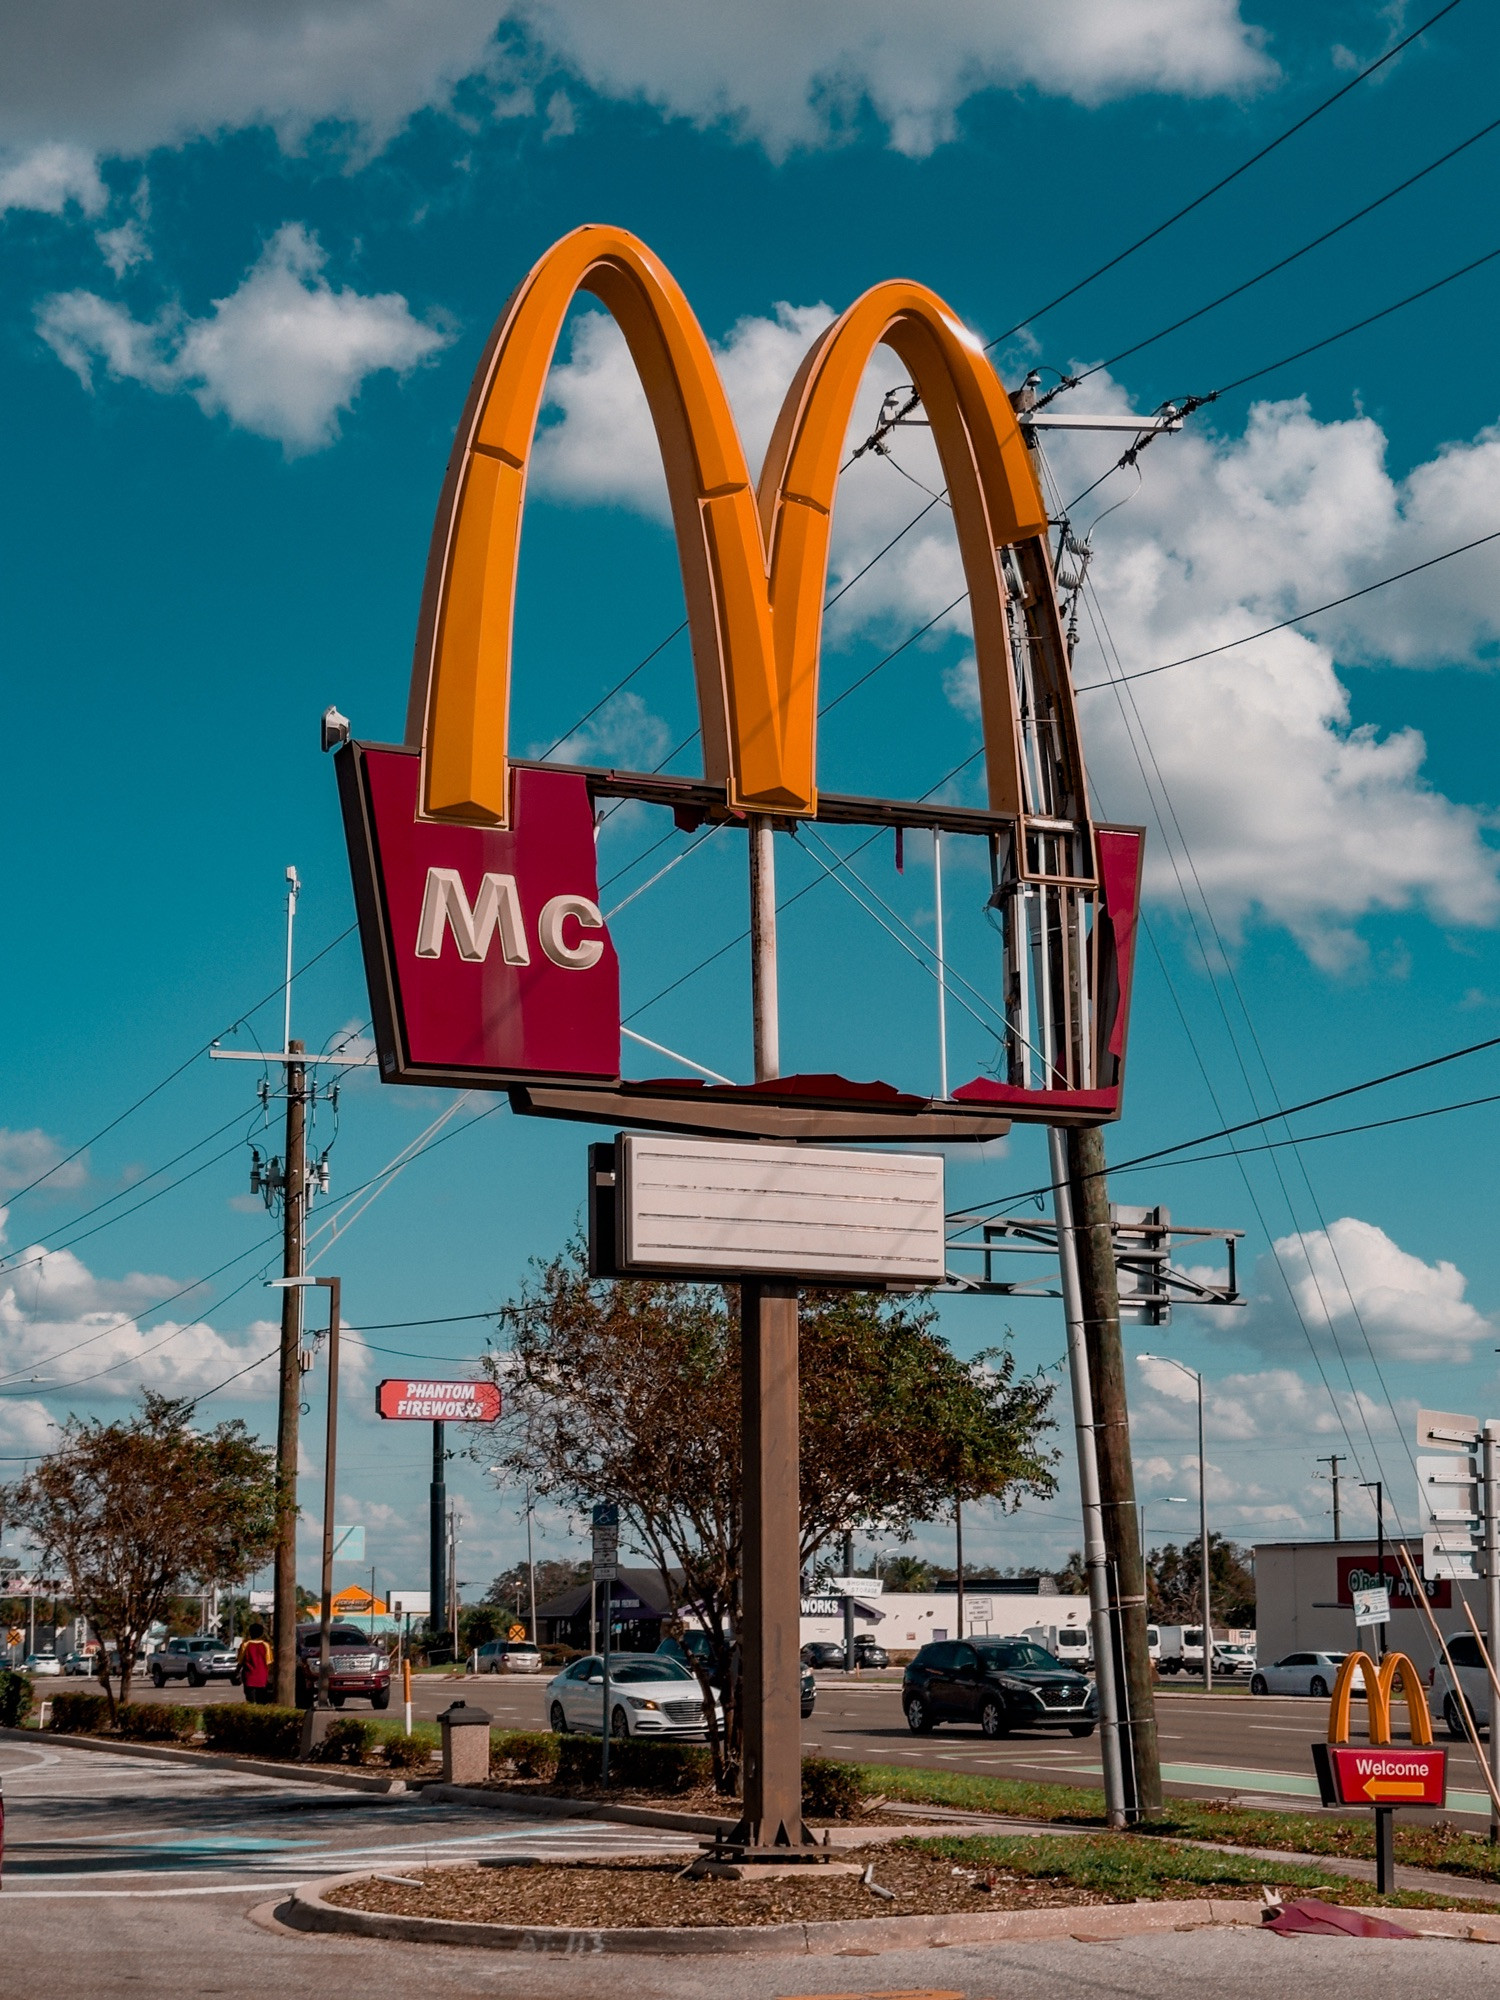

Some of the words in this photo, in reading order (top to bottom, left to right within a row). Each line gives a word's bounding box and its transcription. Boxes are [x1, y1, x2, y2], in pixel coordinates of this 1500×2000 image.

[415, 866, 605, 970] Mc
[406, 1383, 475, 1399] PHANTOM
[397, 1400, 483, 1417] FIREWORKS
[1356, 1759, 1429, 1777] Welcome
